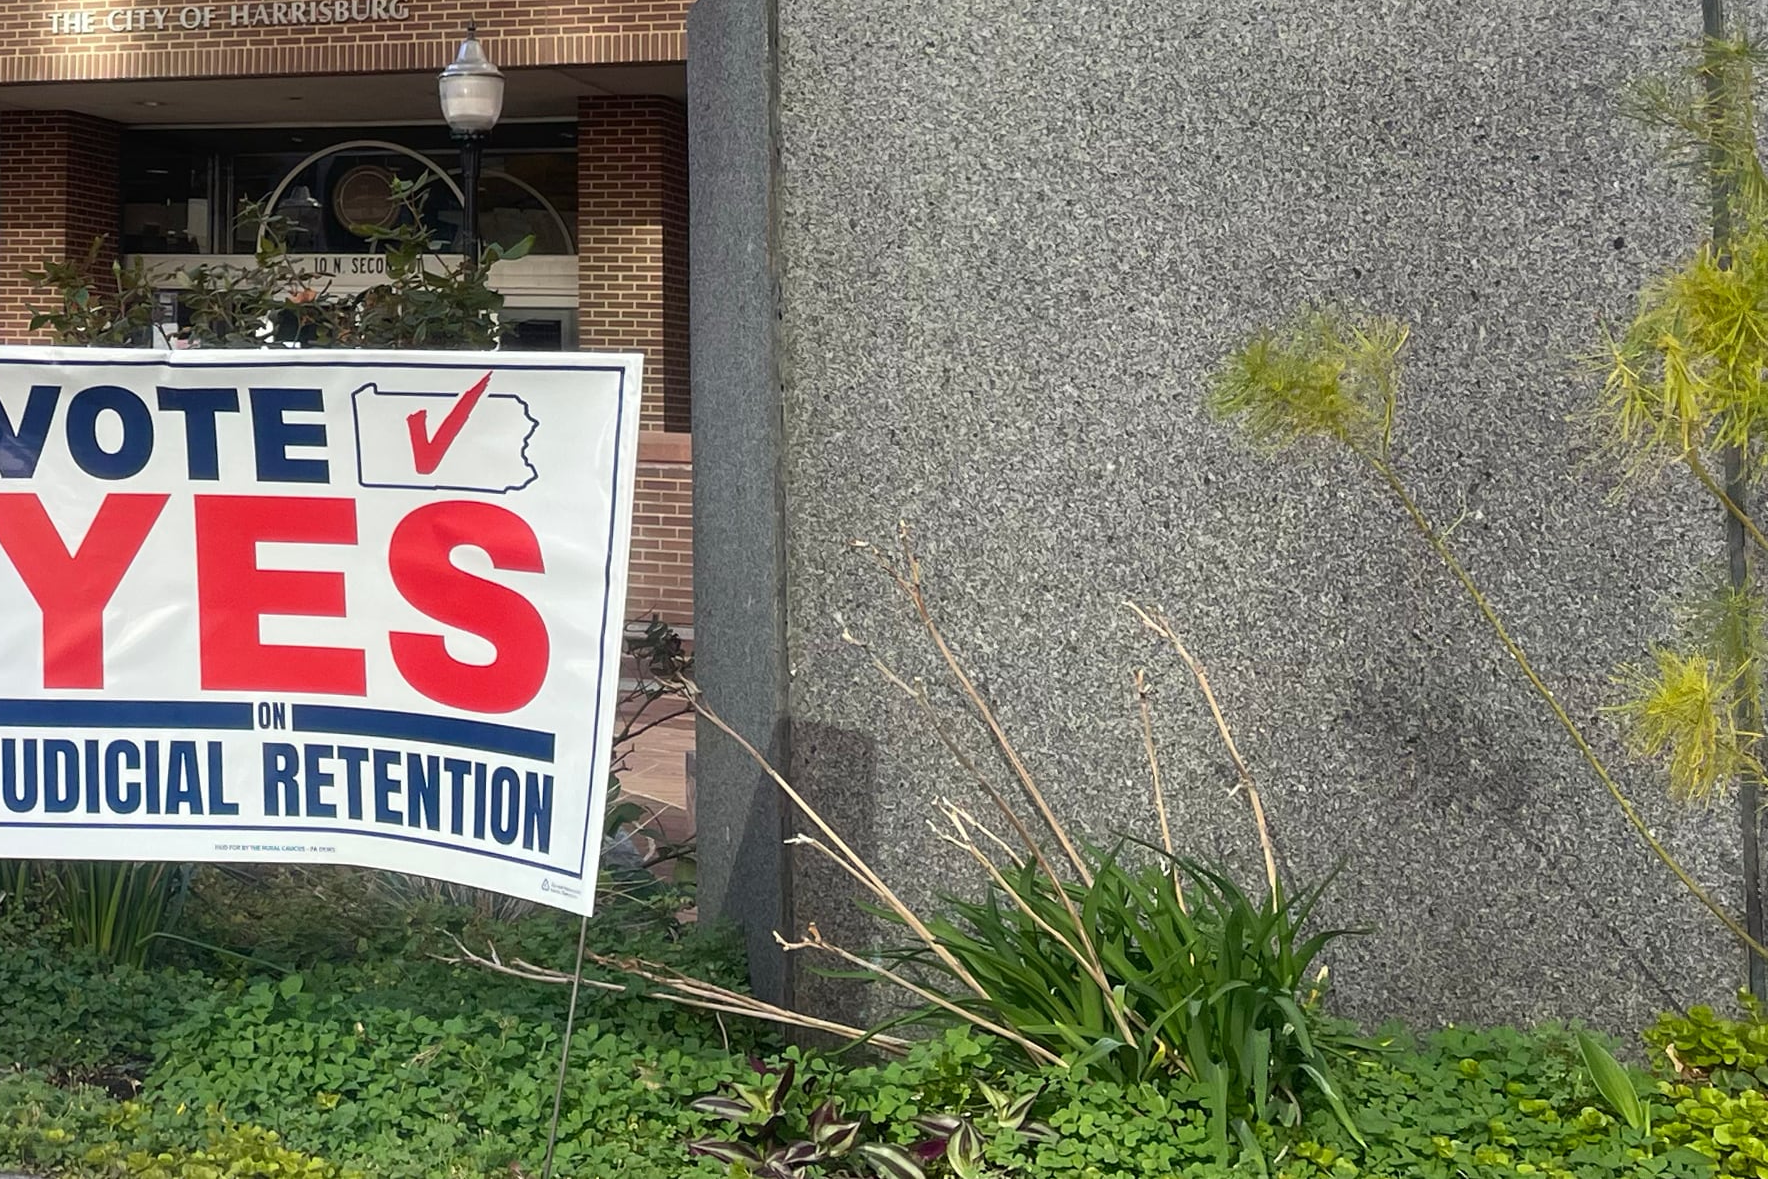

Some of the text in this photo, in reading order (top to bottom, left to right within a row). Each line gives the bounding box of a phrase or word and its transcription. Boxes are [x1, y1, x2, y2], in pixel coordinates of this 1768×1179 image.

[48, 10, 96, 34] THE
[106, 7, 169, 33] CITY
[179, 6, 216, 30] OF
[313, 257, 327, 274] 10
[351, 257, 392, 274] SECO
[257, 702, 287, 730] ON
[263, 742, 554, 853] RETENTION
